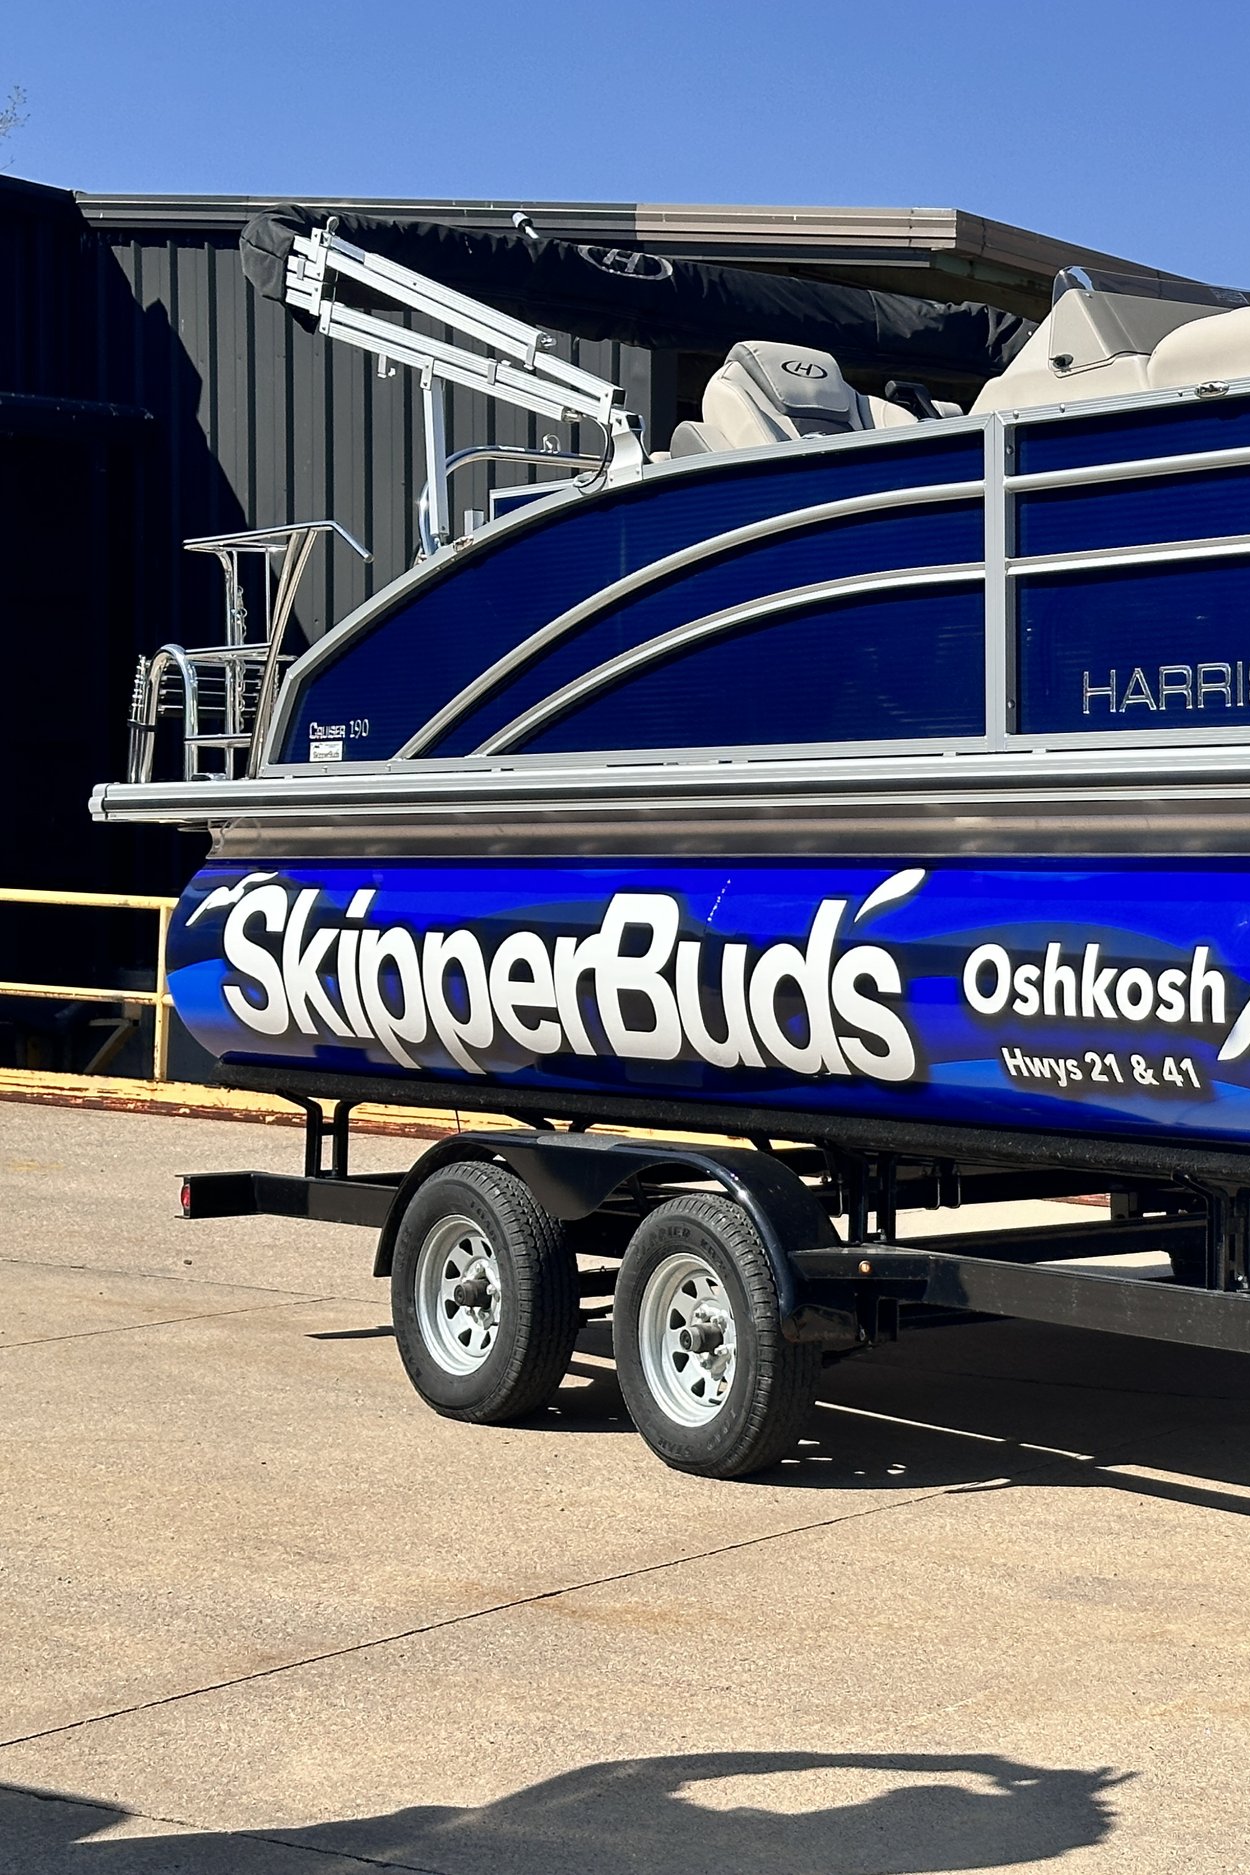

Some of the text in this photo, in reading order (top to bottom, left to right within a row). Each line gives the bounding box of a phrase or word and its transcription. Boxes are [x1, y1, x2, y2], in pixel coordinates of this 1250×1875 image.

[349, 718, 369, 739] 190
[963, 942, 1226, 1024] Oshkosh
[1001, 1047, 1201, 1089] Hwys 21 & 41
